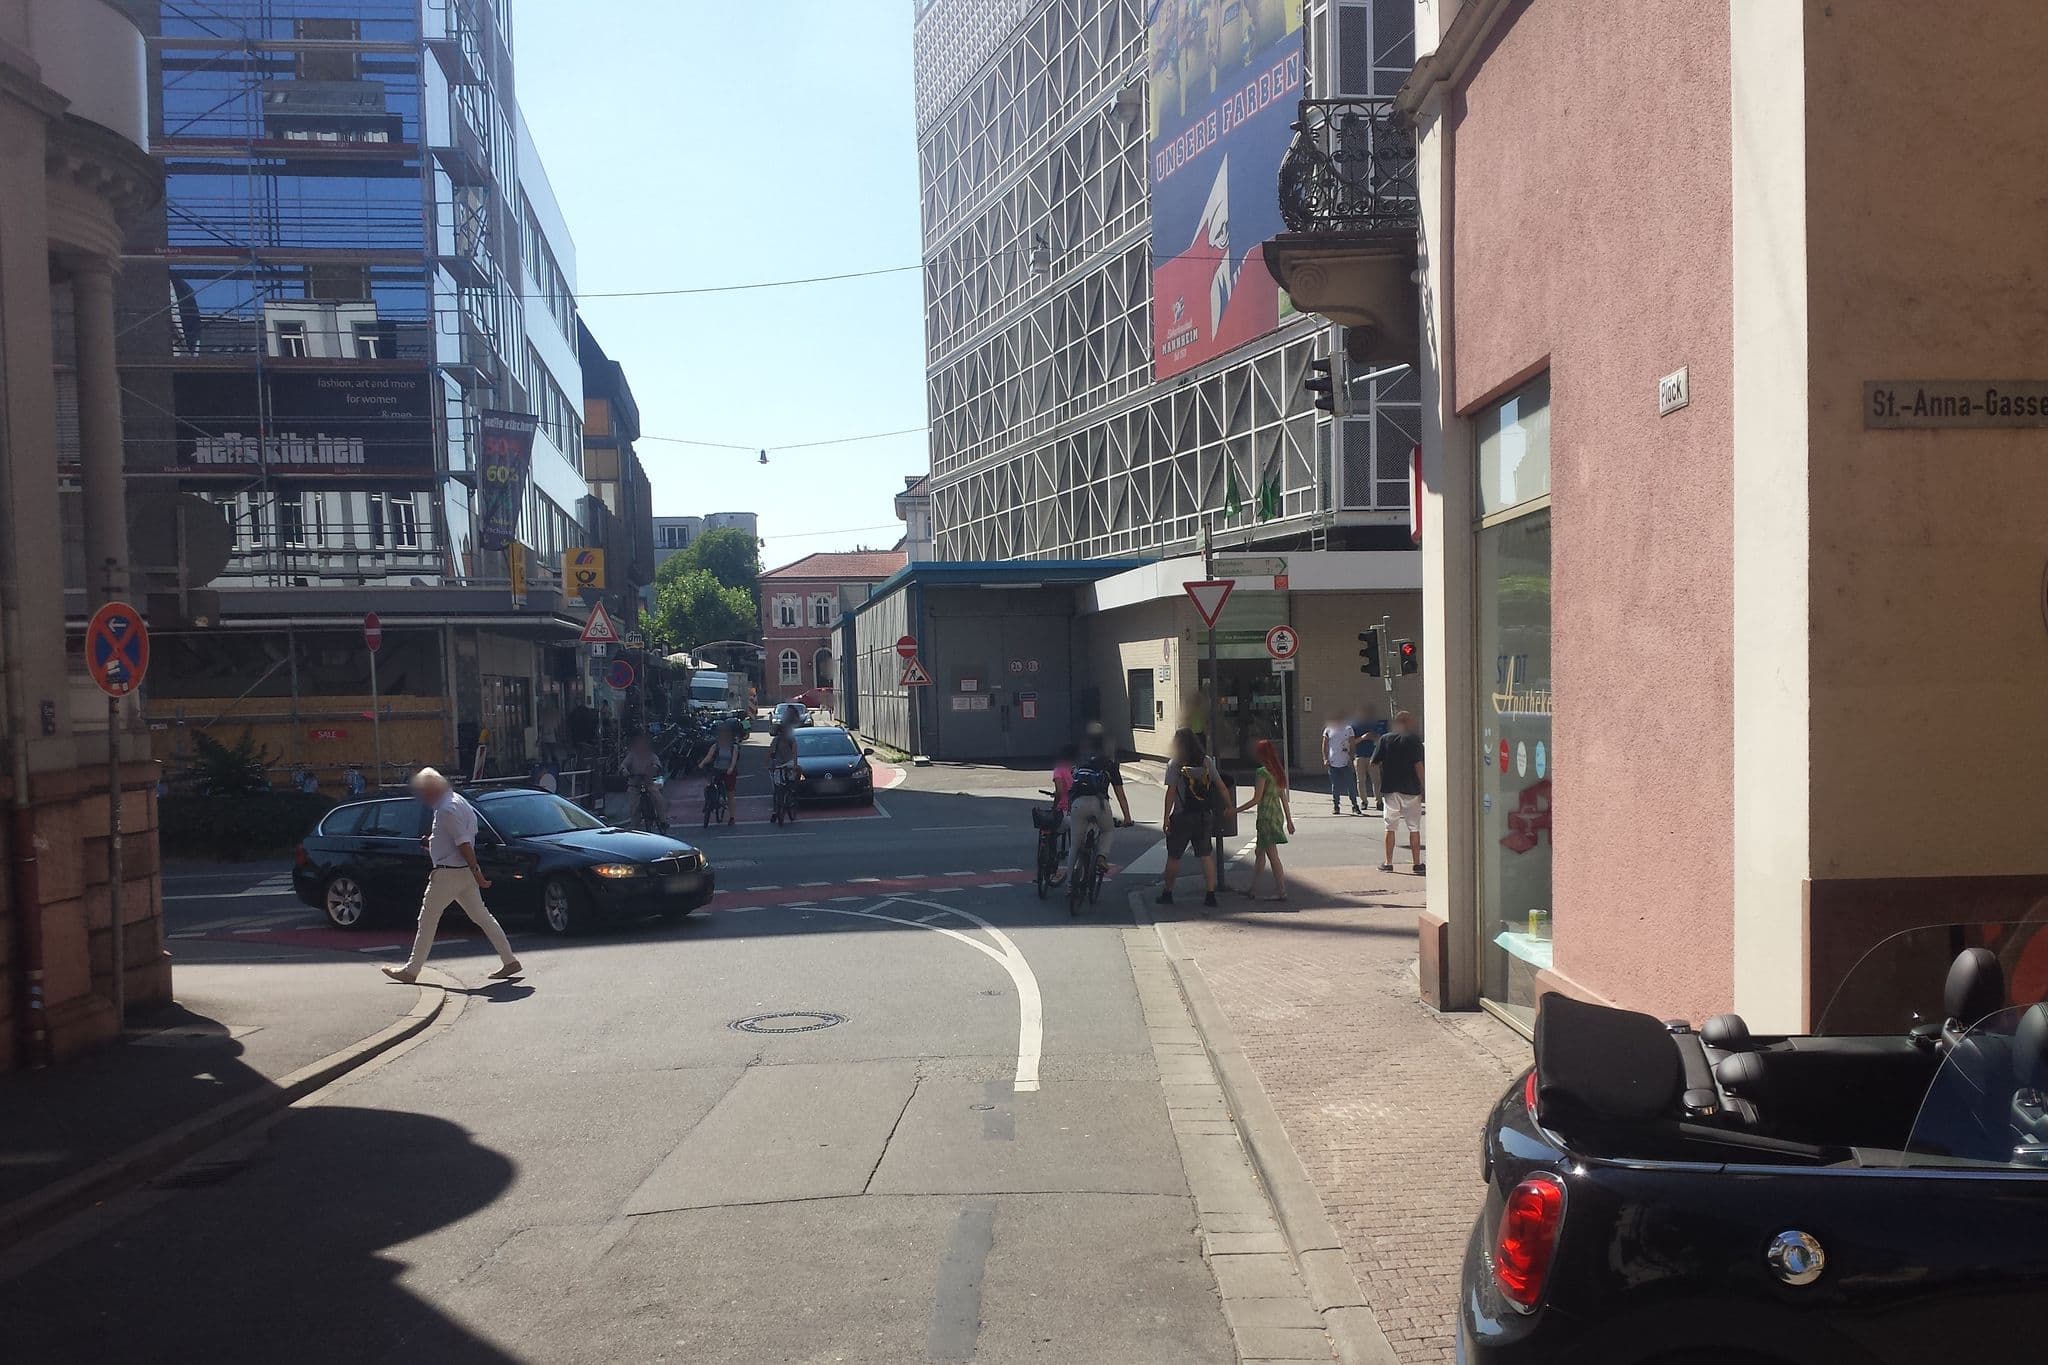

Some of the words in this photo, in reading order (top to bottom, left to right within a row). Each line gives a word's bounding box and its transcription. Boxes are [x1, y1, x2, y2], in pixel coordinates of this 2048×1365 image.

[1155, 110, 1217, 183] UNSERE
[1222, 50, 1300, 135] FARBEN
[317, 378, 355, 389] fashion,
[390, 380, 417, 388] more
[1661, 374, 1683, 408] Plöck
[346, 393, 360, 404] for
[361, 395, 398, 404] women
[1872, 388, 2048, 417] St.-Anna-Gasse
[1491, 655, 1552, 722] Apotheke
[317, 730, 337, 739] SALE
